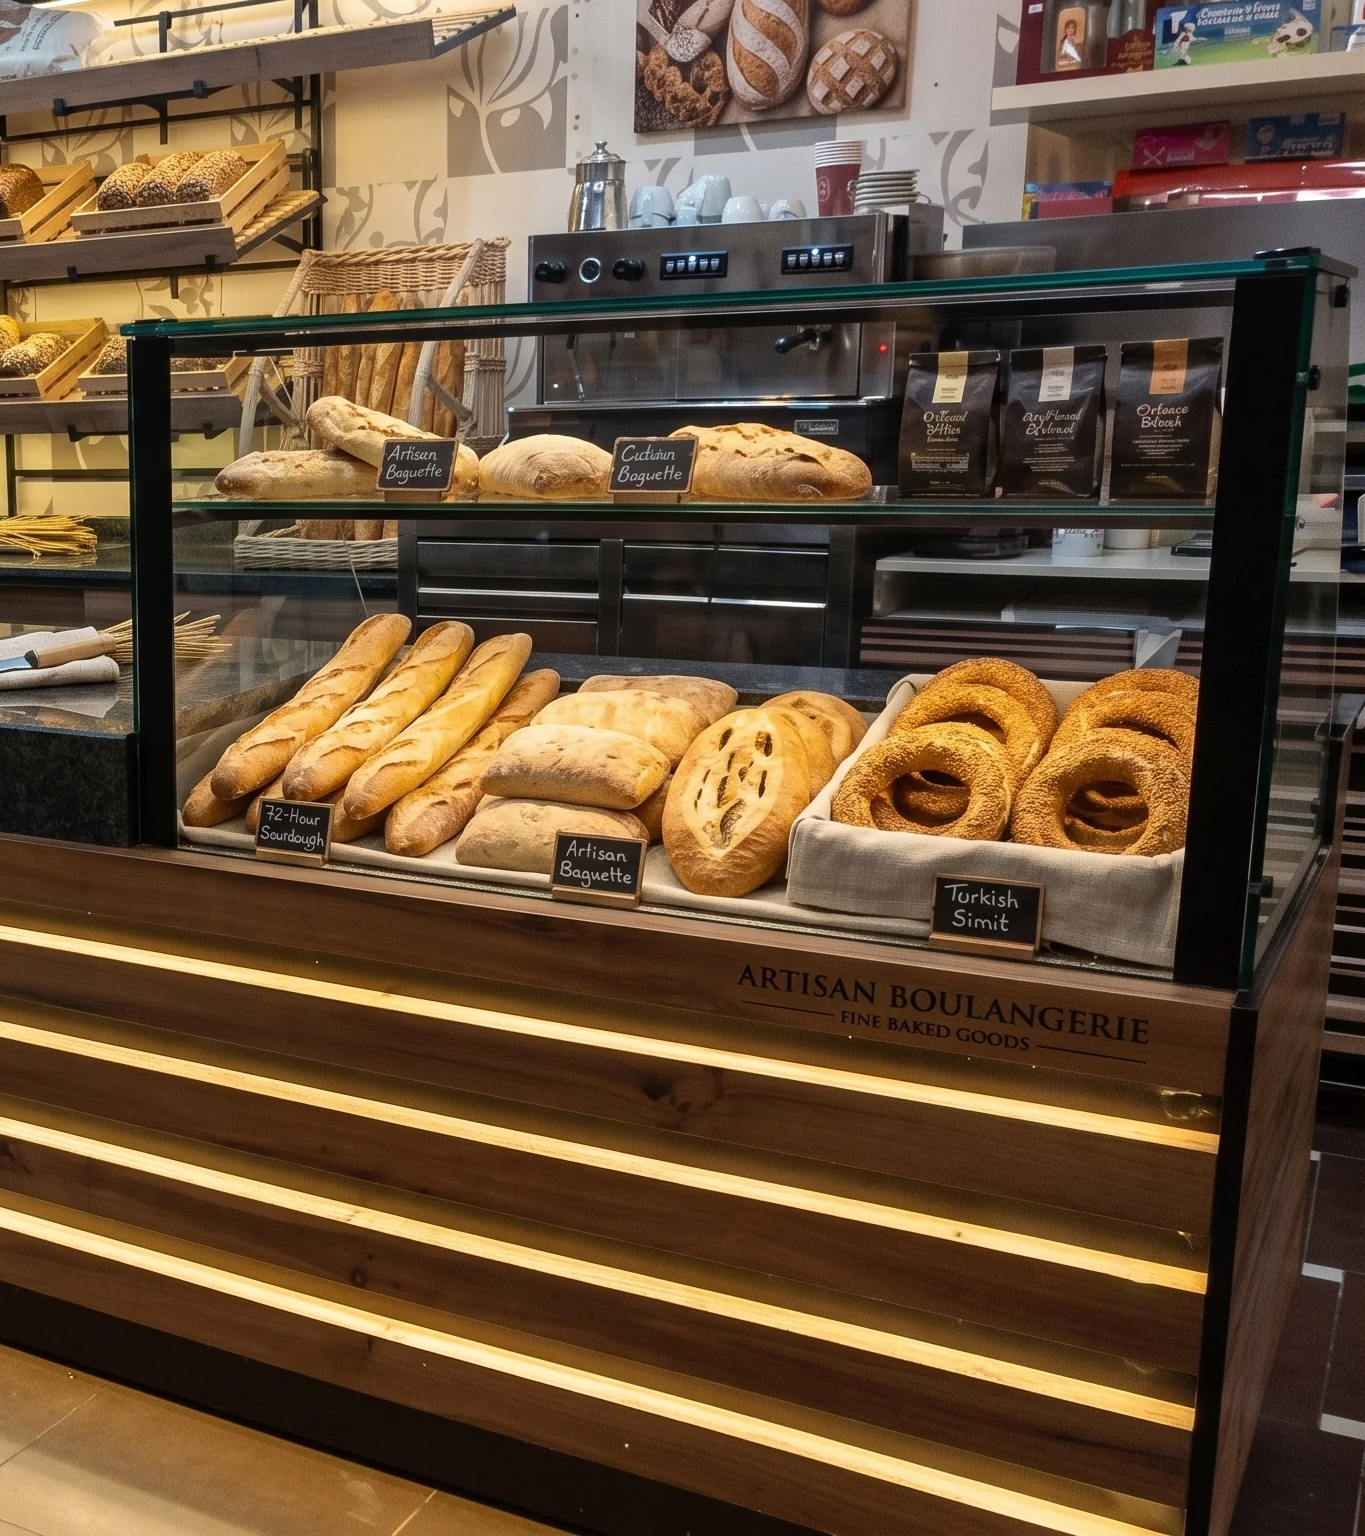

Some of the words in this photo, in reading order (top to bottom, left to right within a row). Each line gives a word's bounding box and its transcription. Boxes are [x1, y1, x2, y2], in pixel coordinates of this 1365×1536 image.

[387, 444, 438, 461] Artisan
[386, 463, 443, 485] Baguette
[617, 465, 683, 487] Baguette
[265, 804, 321, 826] 72-Hour
[566, 840, 628, 863] Artisan
[560, 860, 632, 888] Baguette
[944, 883, 1019, 909] Turkish
[952, 909, 1010, 932] Simit
[737, 964, 877, 1005] ARTISAN
[889, 984, 1150, 1045] BOULANGERIE
[841, 1010, 882, 1029] FINE
[888, 1017, 951, 1039] BAKED
[956, 1027, 1031, 1051] GOODS
